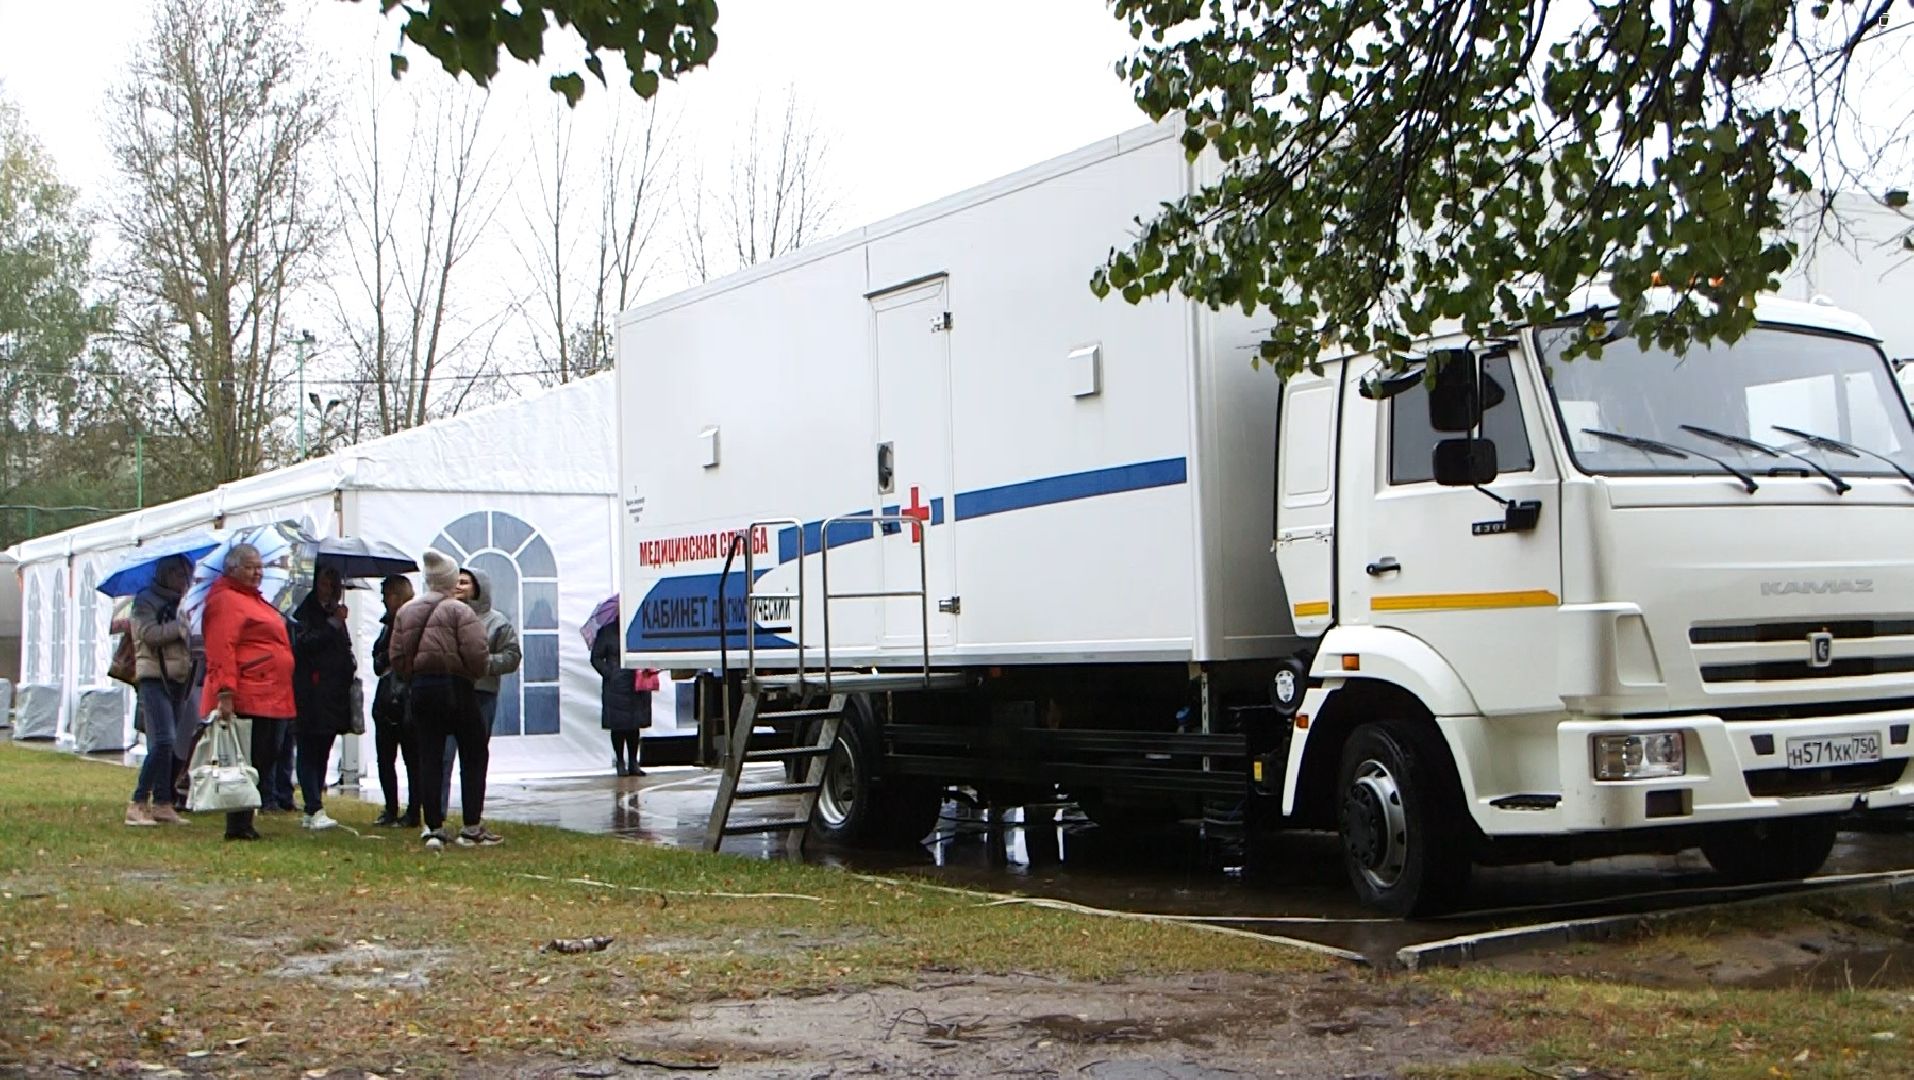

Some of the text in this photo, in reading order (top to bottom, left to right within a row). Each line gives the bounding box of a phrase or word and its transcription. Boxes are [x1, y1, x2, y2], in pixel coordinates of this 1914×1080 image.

[639, 533, 717, 568] МЕДИЦИНСКАЯ
[1760, 578, 1874, 596] KAMAZ
[643, 595, 708, 629] КАБИНЕТ
